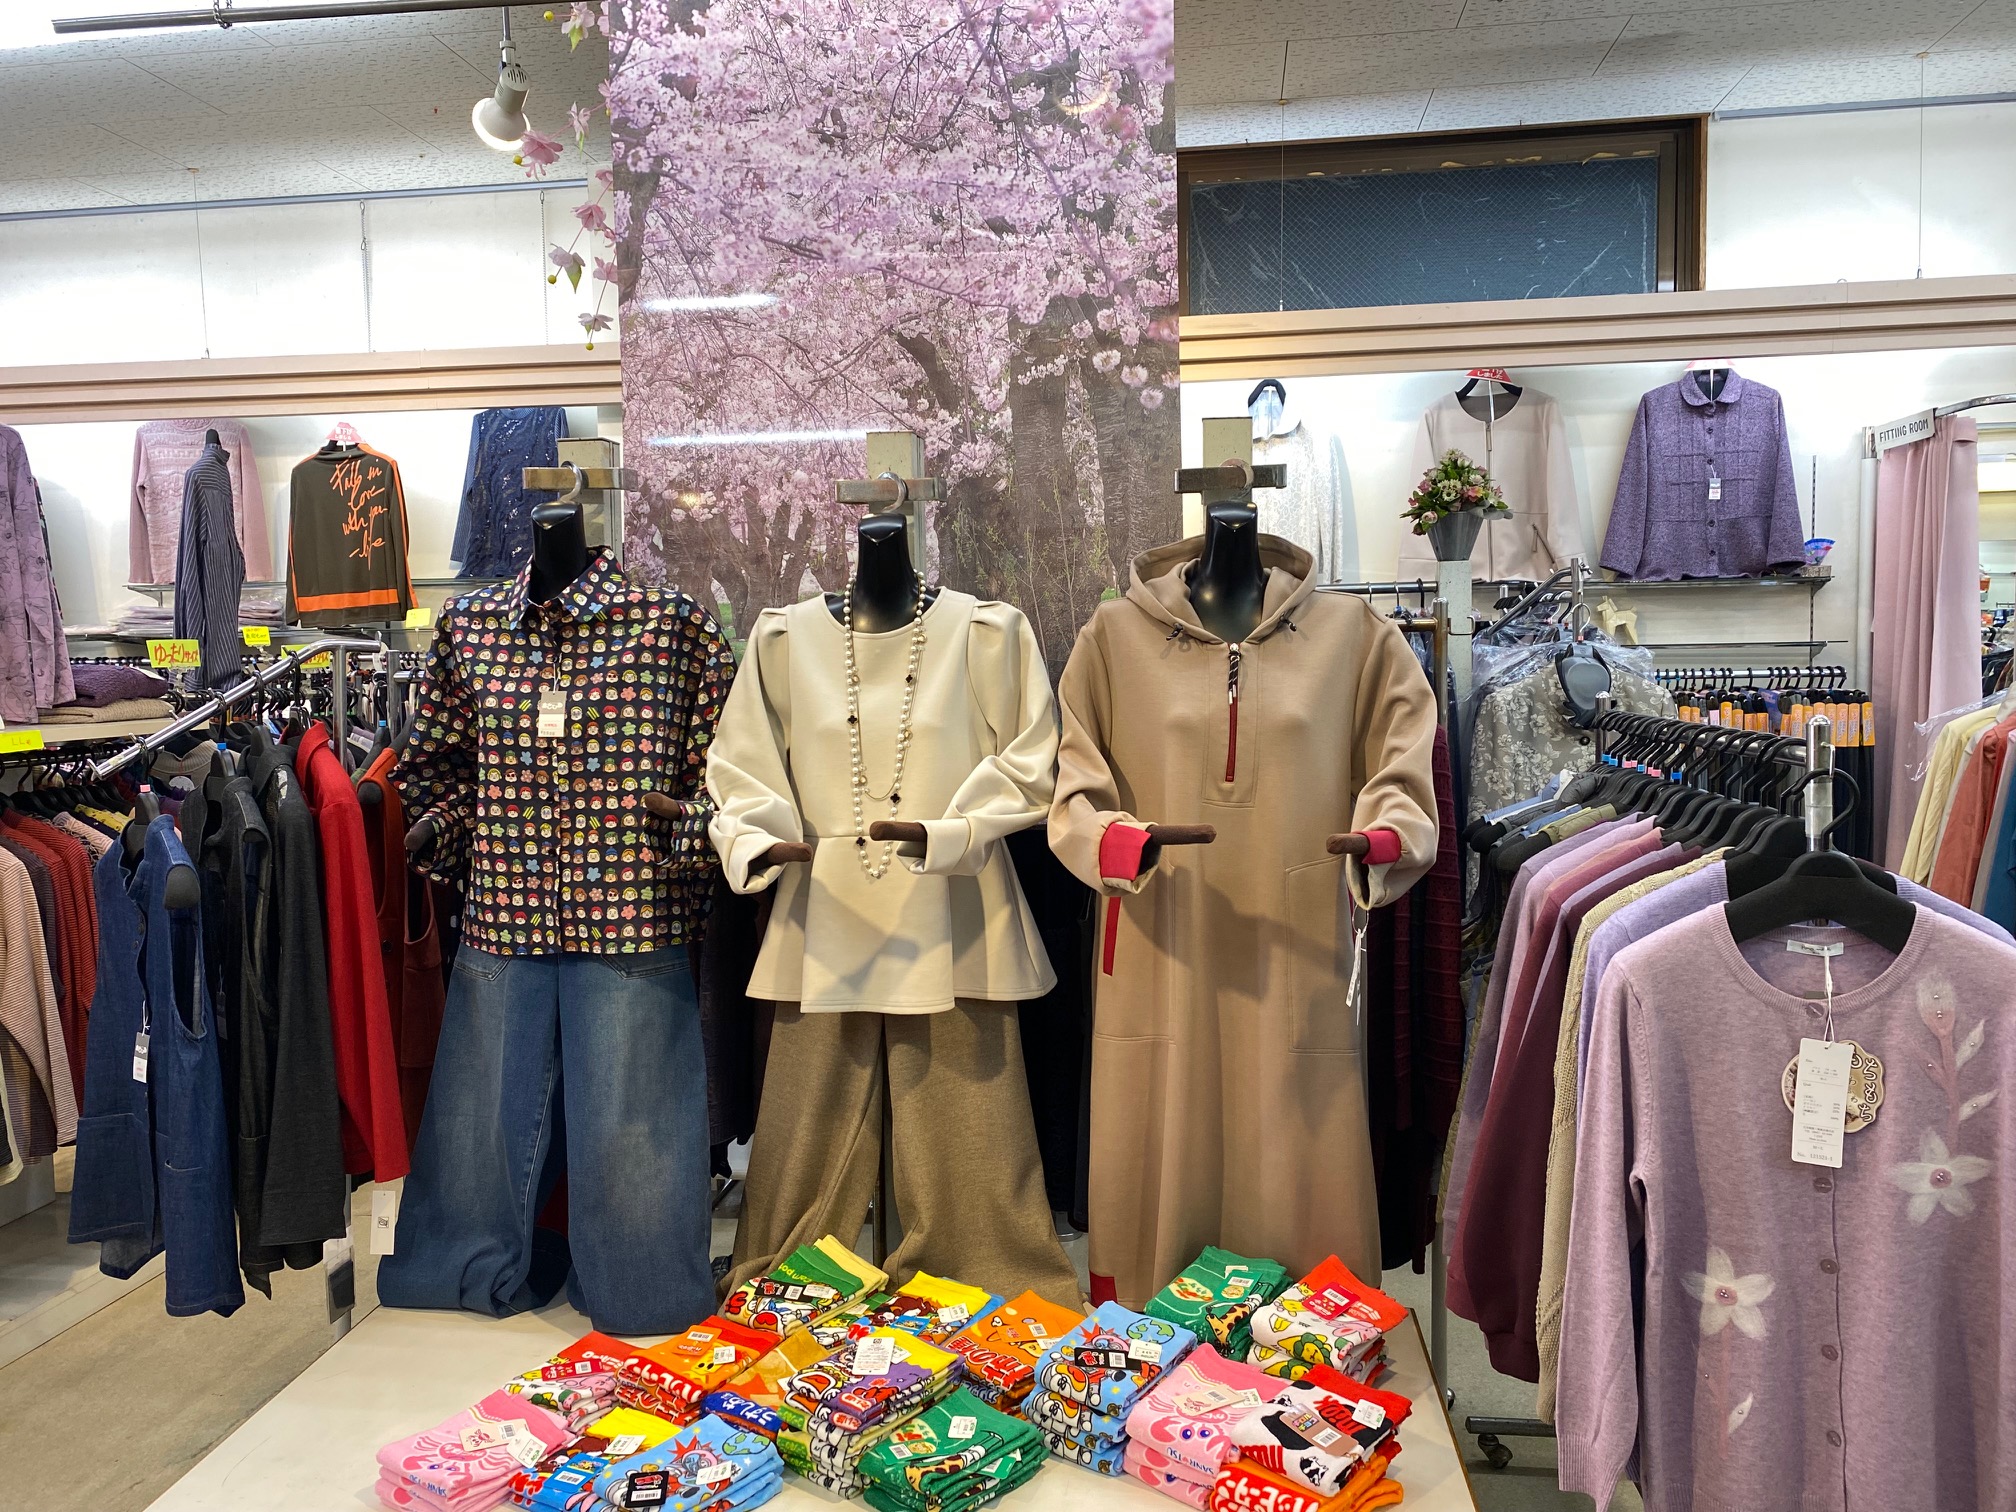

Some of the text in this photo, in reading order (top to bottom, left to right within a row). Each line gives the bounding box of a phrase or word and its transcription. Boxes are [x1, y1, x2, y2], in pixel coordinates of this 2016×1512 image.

[1477, 371, 1503, 380] しました
[1879, 418, 1930, 443] FITTING ROOM
[945, 1334, 1035, 1391] 柿の種
